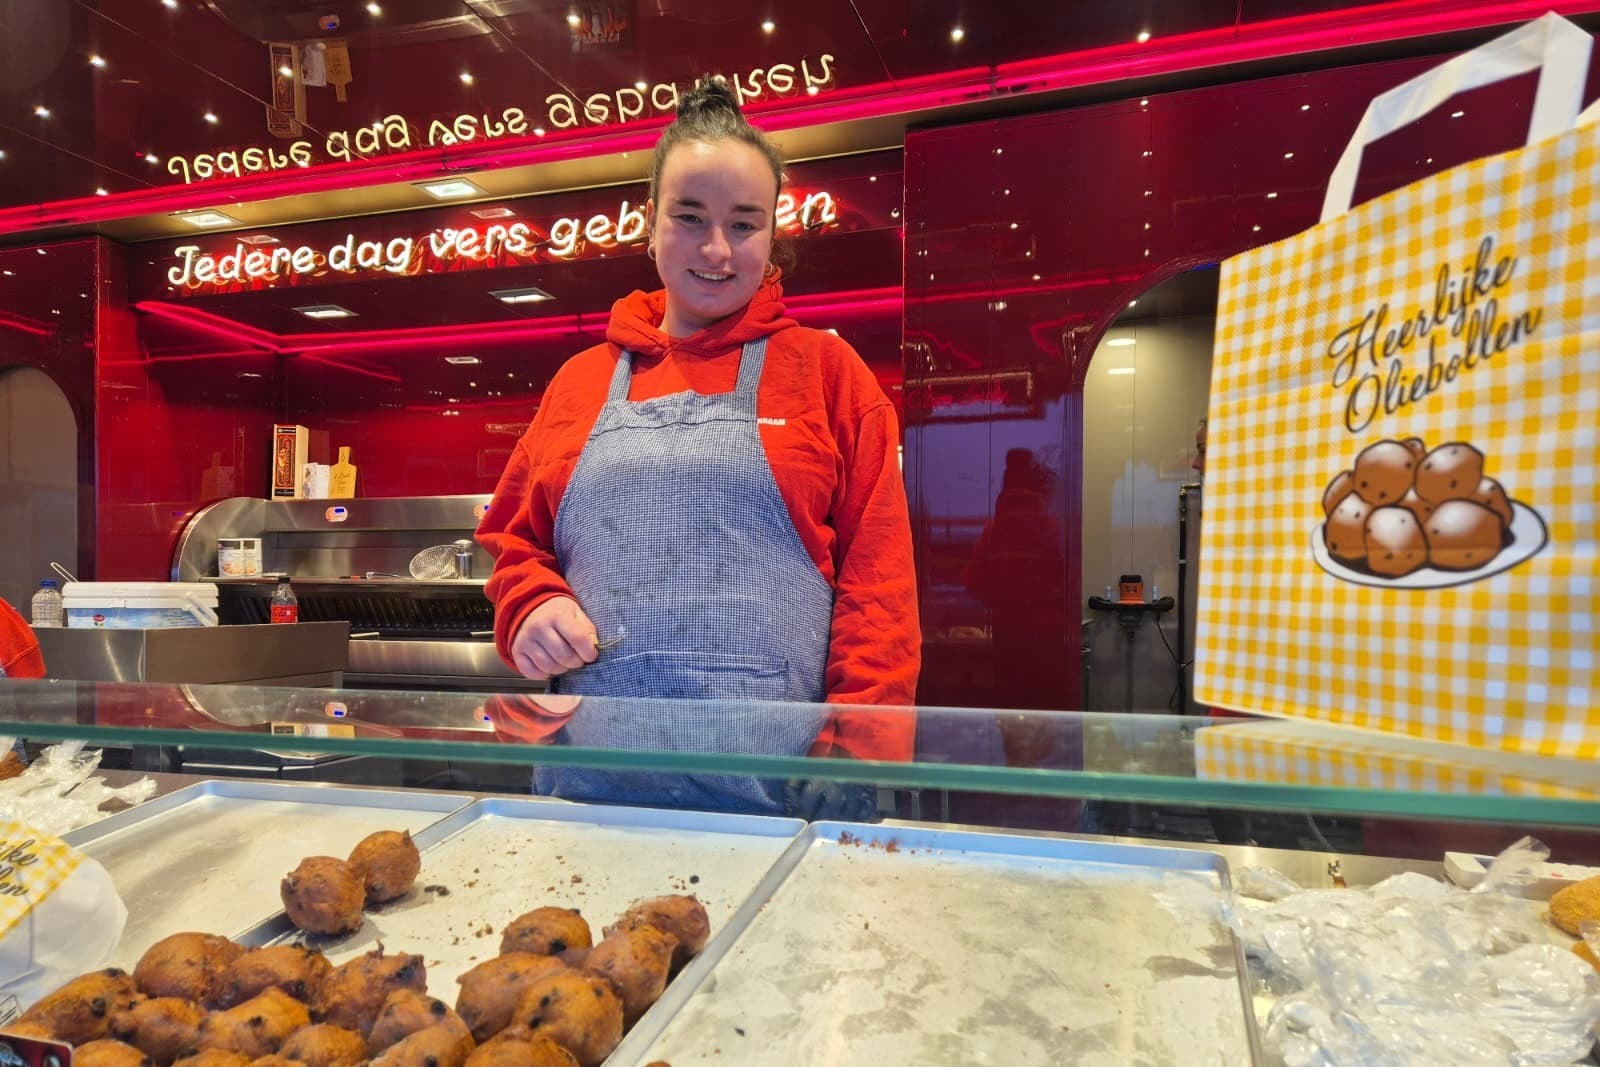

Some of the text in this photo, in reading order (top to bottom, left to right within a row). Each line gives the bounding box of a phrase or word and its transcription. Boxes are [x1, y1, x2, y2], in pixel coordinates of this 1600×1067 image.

[328, 233, 414, 274] dag
[429, 221, 530, 257] vers
[1327, 235, 1519, 389] Heerlijke
[1345, 297, 1543, 434] Oliebollen
